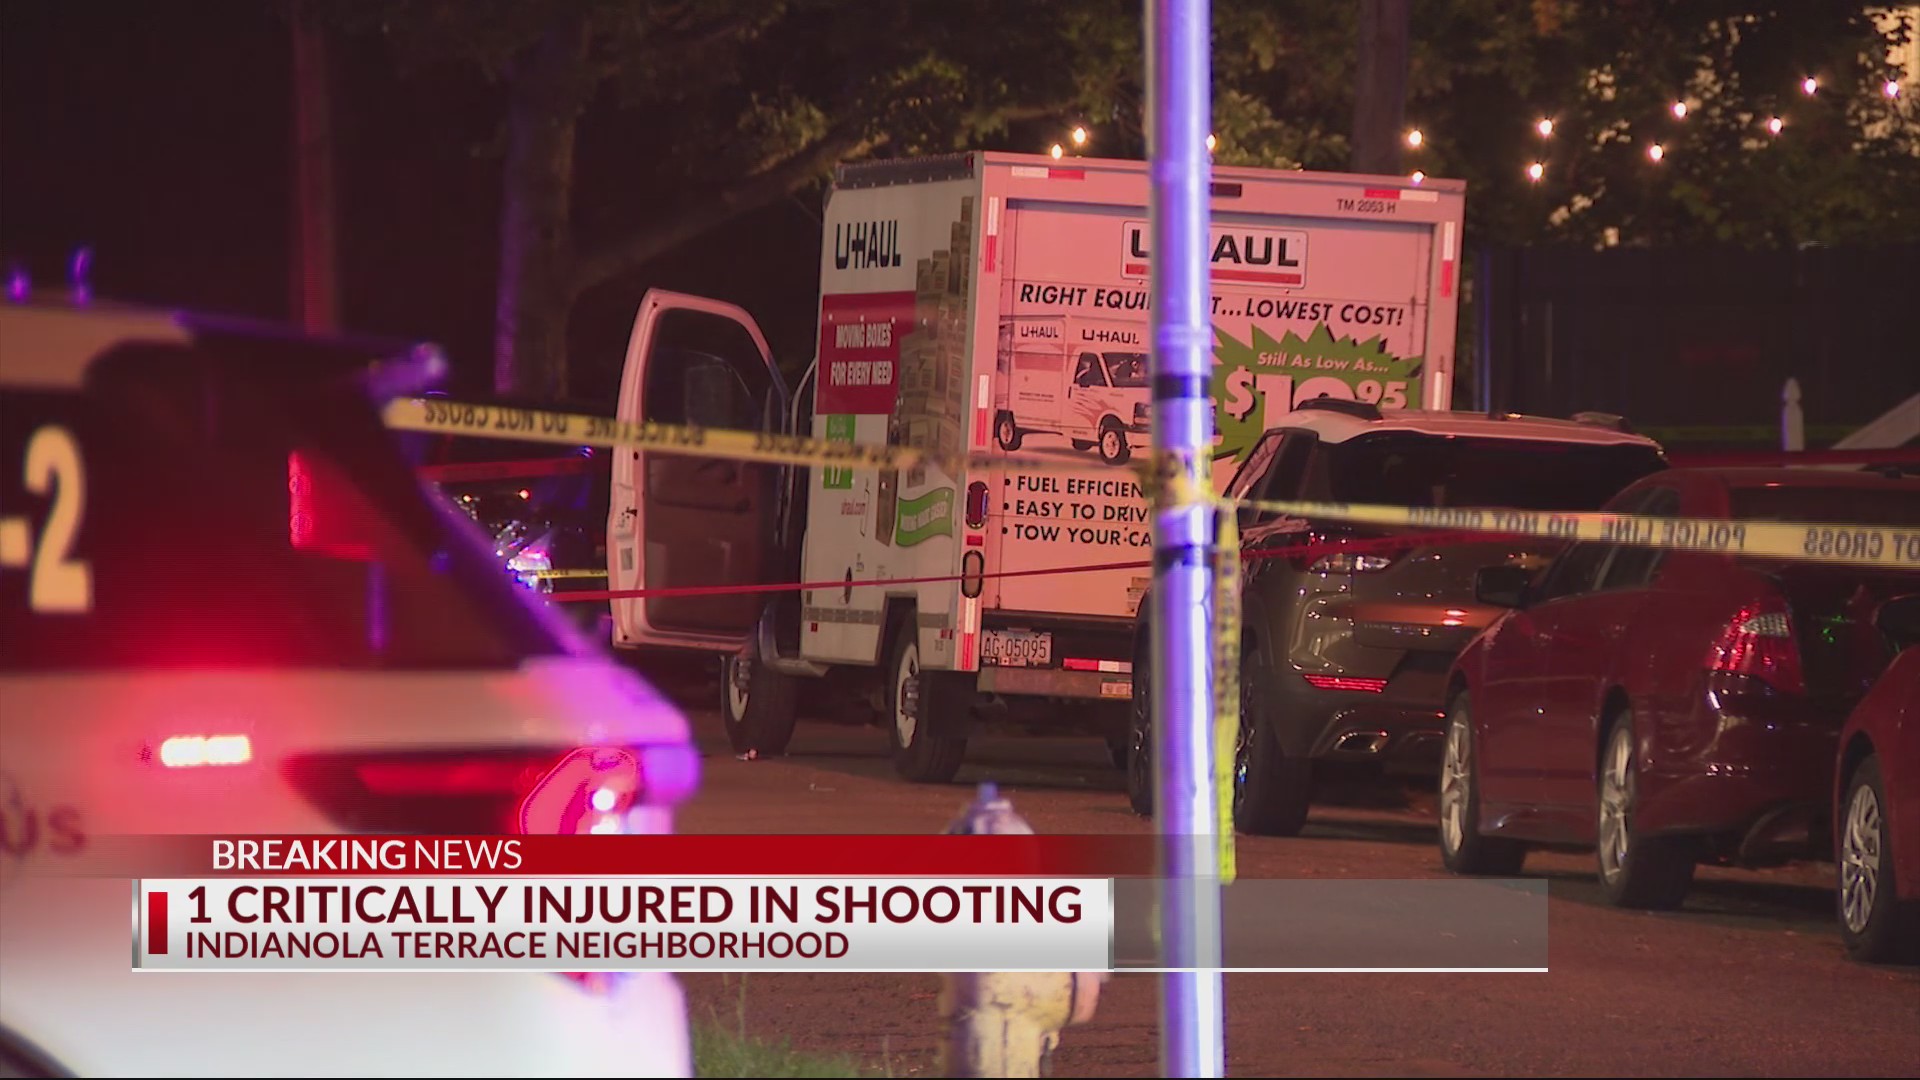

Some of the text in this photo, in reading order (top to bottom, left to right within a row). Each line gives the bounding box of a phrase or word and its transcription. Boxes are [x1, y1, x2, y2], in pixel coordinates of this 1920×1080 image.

[1336, 198, 1354, 211] TM
[1387, 202, 1396, 213] H
[835, 219, 901, 269] U-HAUL
[1020, 284, 1087, 307] RIGHT
[1341, 304, 1404, 326] COST!
[835, 322, 892, 349] MOVING BOXES
[1020, 325, 1059, 339] U-HAUL
[1082, 329, 1140, 345] U-HAUL
[830, 360, 893, 386] FOR EVERY NEED
[1257, 352, 1389, 373] Still As Low As...
[424, 400, 489, 427] CROSS
[494, 407, 535, 431] NOT
[1017, 475, 1144, 498] FUEL EFFICIEN
[1016, 499, 1148, 522] EASY TO DRIV
[1014, 523, 1153, 546] TOW YOUR CA
